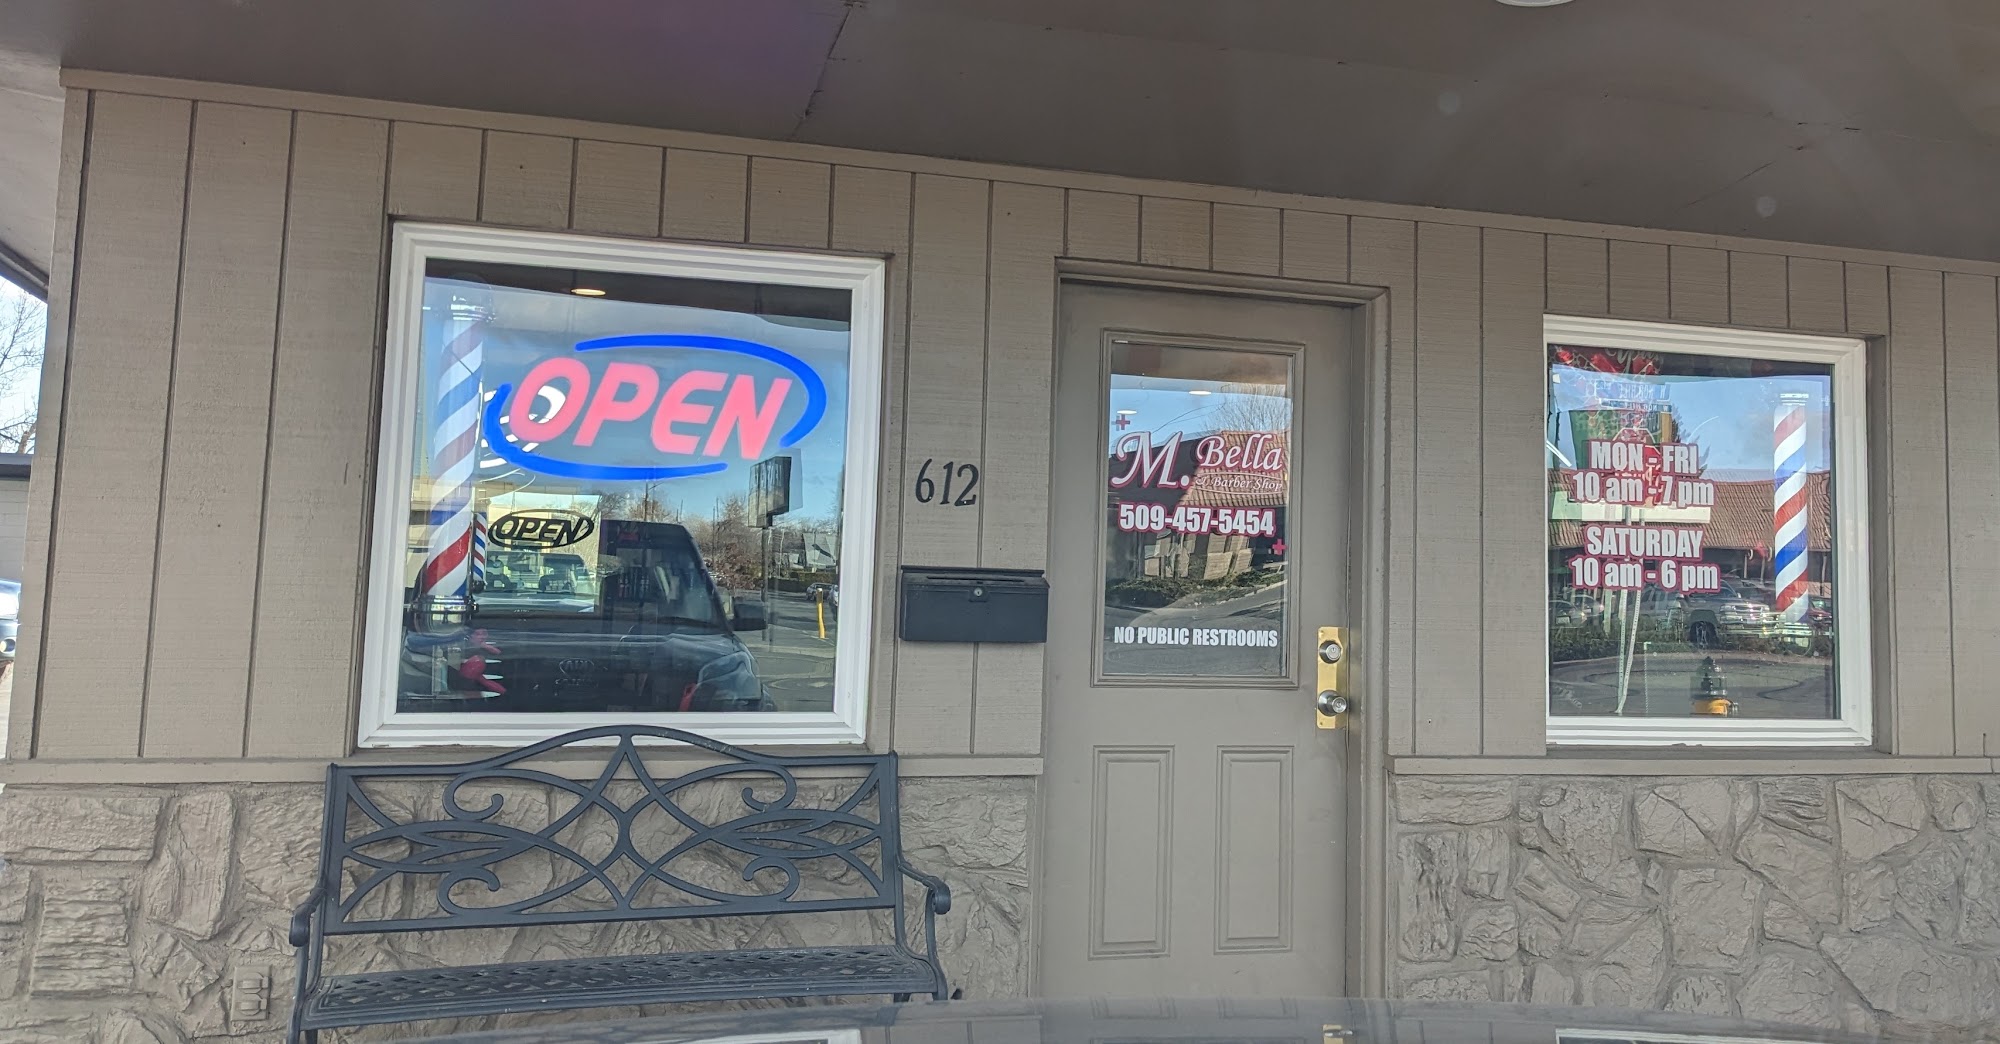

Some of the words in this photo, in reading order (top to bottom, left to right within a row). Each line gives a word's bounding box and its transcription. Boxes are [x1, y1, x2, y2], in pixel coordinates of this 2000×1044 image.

[508, 356, 793, 461] OPEN
[1196, 433, 1283, 471] Bella
[1590, 441, 1644, 471] MON
[1661, 445, 1698, 474] FRI
[915, 458, 979, 507] 612
[1212, 475, 1251, 488] Barber
[1253, 478, 1283, 491] Shop
[1572, 471, 1600, 501] 10
[1605, 477, 1643, 502] am
[1661, 475, 1673, 504] 7
[1677, 480, 1715, 508] pm
[499, 516, 589, 547] OPEN
[1119, 503, 1275, 536] 509-457-5454
[1586, 526, 1704, 558] SATURDAY
[1571, 557, 1599, 587] 10
[1604, 562, 1642, 588] am
[1661, 559, 1676, 588] 6
[1681, 565, 1718, 592] pm
[1114, 627, 1135, 644] NO
[1137, 627, 1190, 646] PUBLIC
[1192, 629, 1278, 647] RESTROOMS
